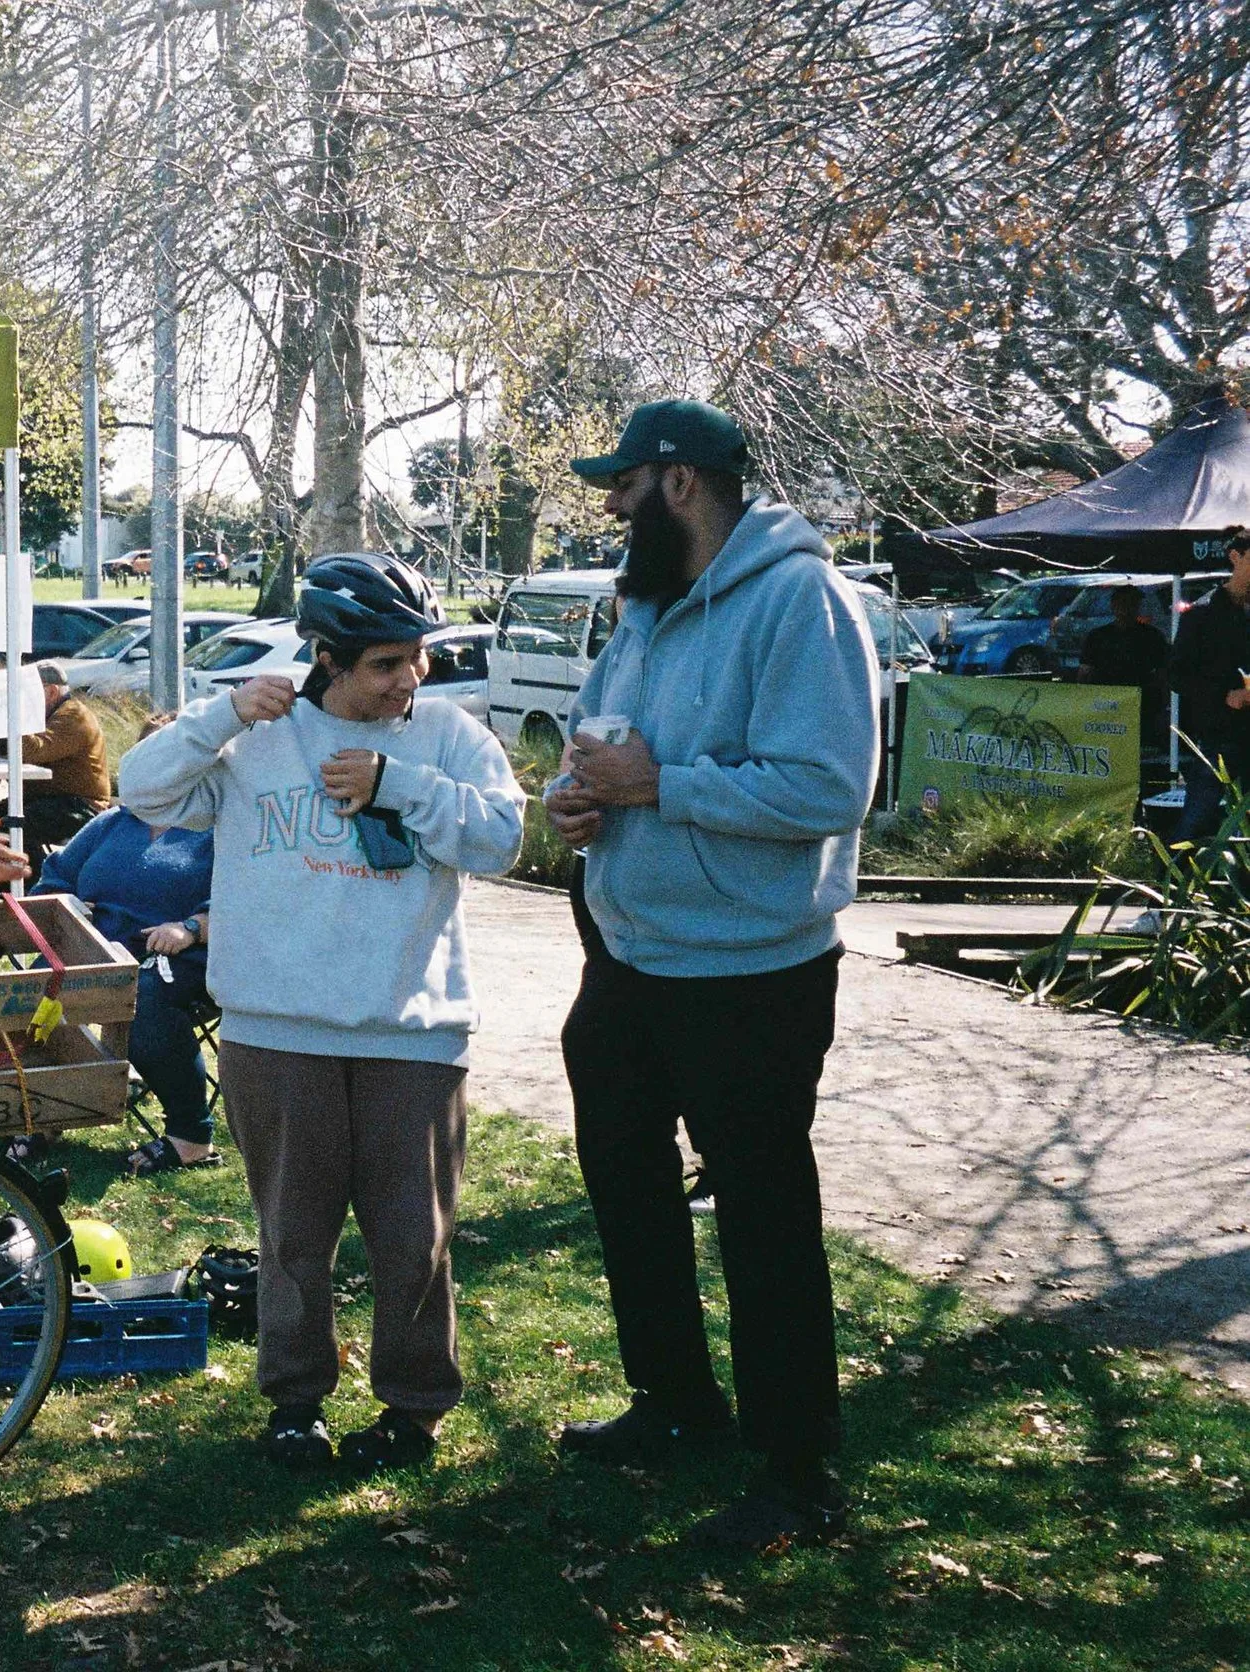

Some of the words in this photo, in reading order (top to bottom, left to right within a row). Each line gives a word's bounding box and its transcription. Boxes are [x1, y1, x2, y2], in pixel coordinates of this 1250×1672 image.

[924, 729, 1036, 771] MAKIMA
[1038, 741, 1111, 779] EATS
[303, 856, 335, 873] New
[336, 858, 371, 879] York
